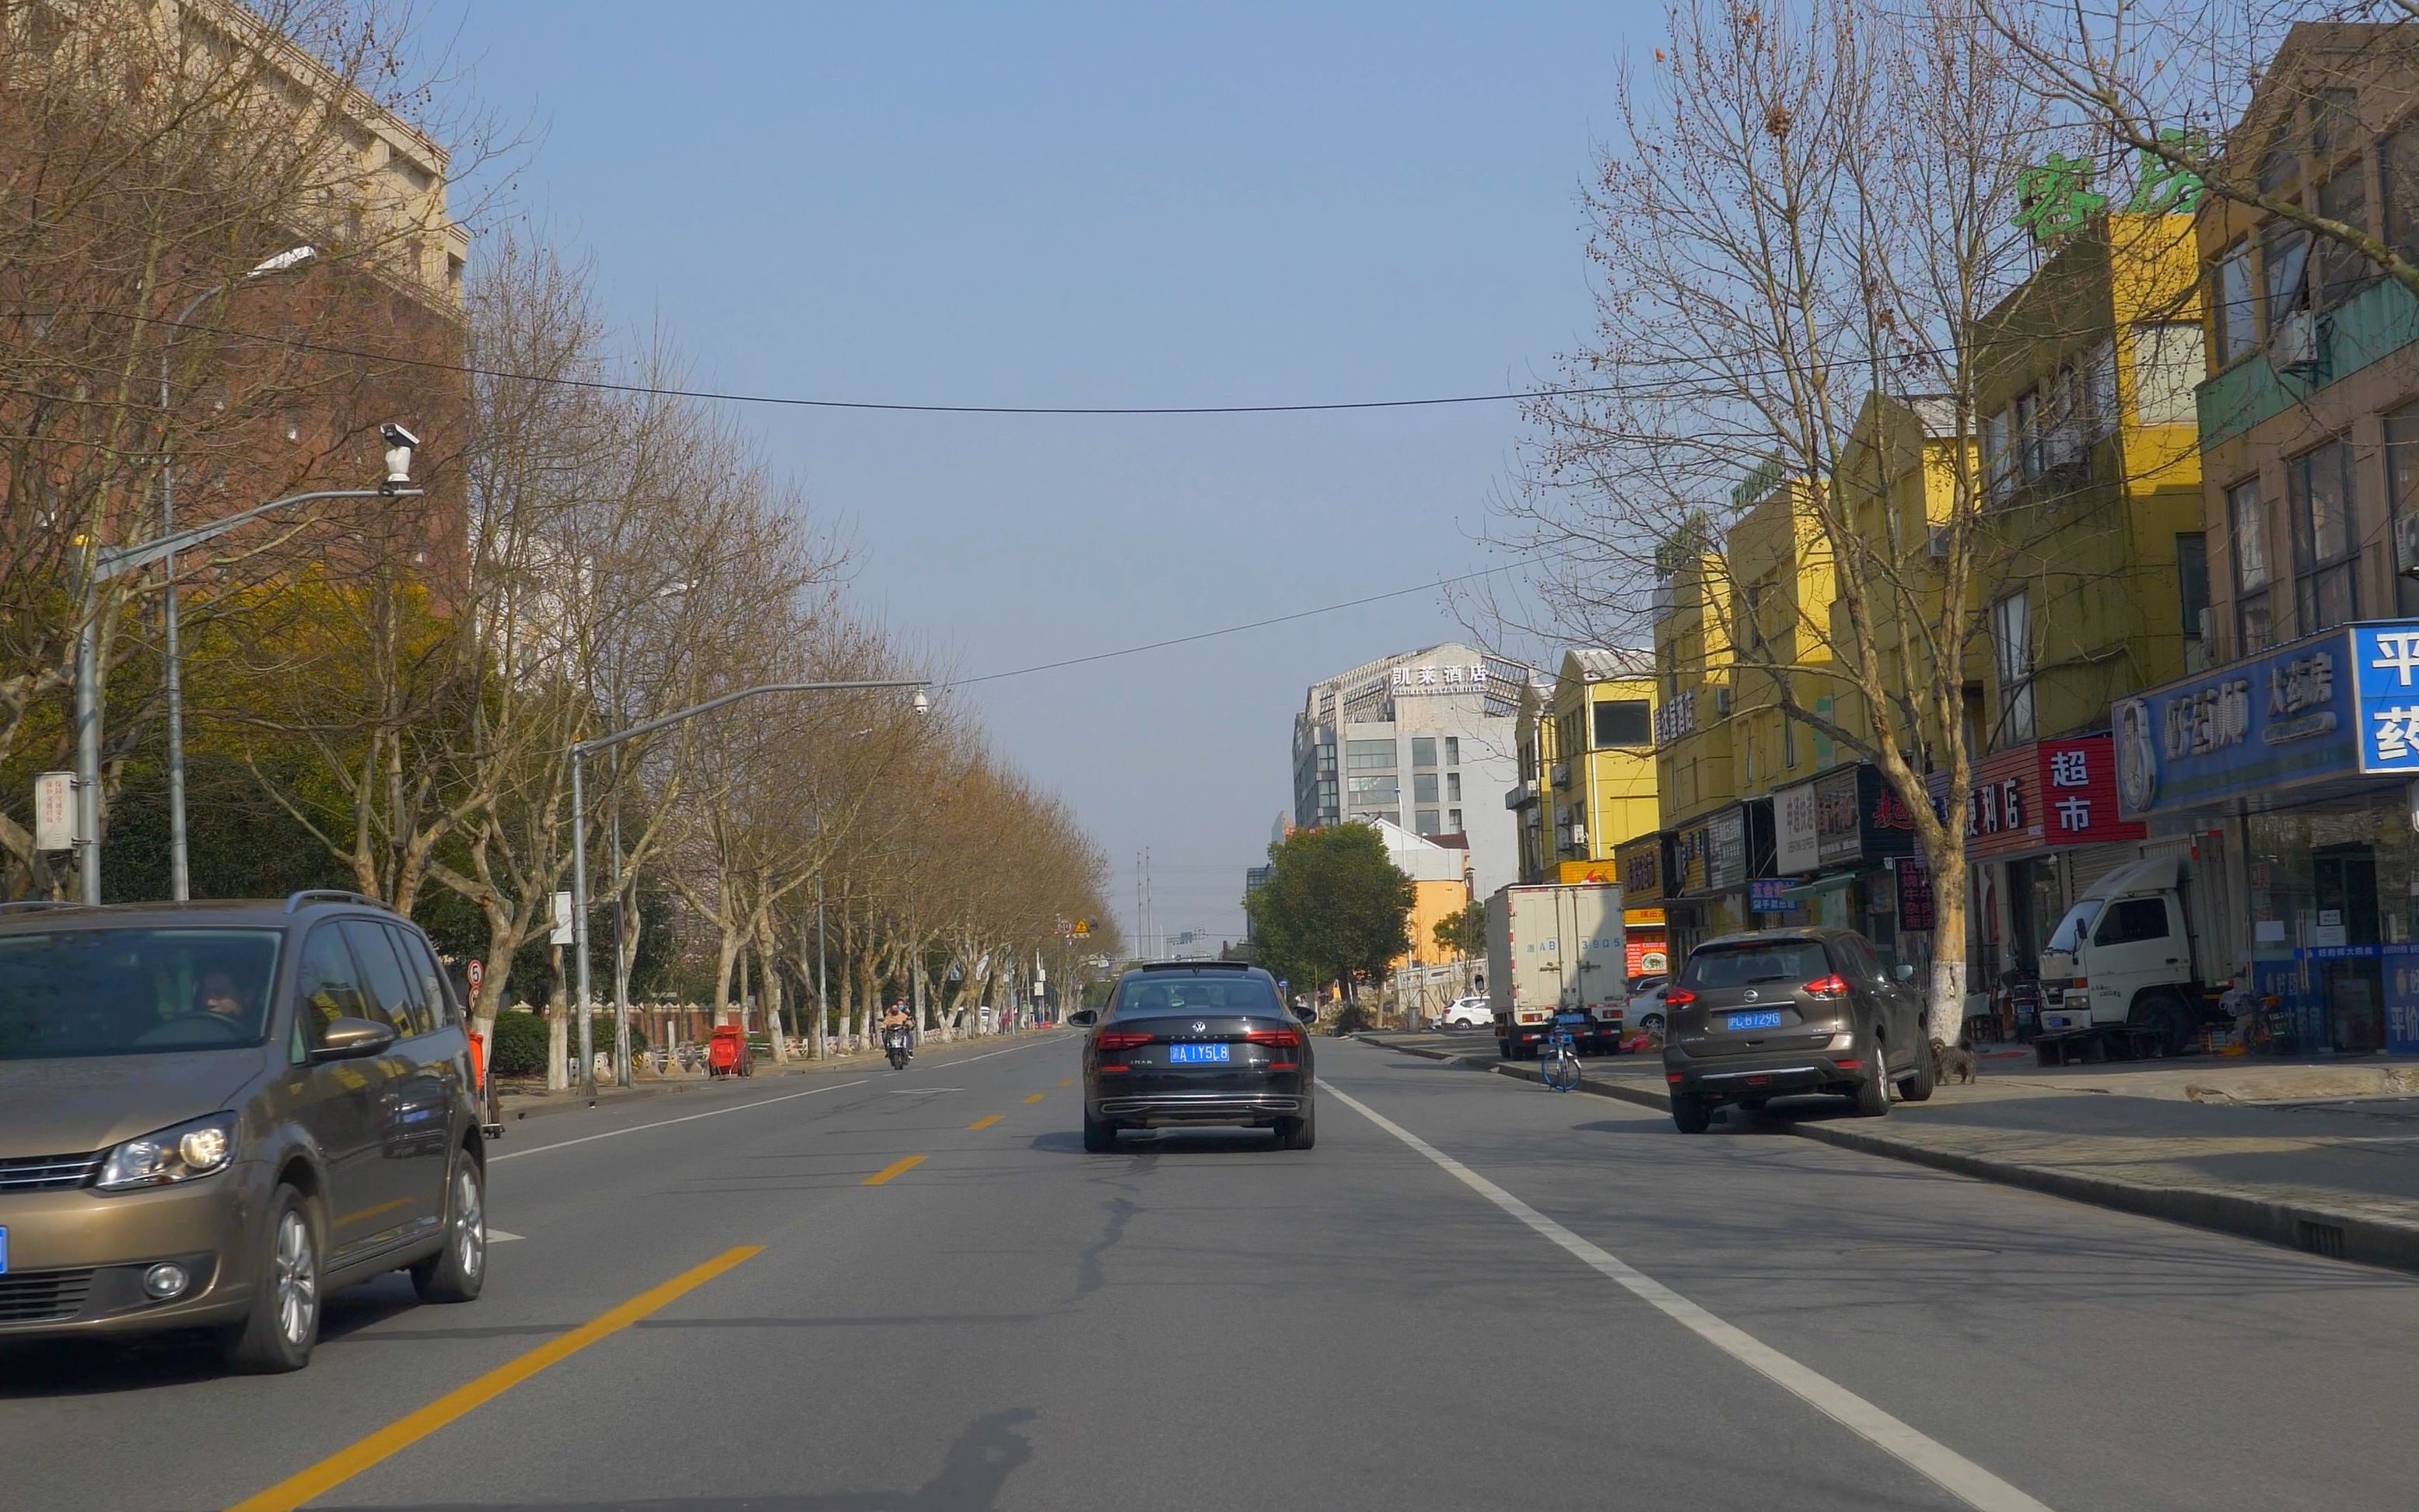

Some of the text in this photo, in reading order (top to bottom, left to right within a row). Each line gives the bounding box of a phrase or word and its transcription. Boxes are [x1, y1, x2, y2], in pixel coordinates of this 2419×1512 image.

[1392, 663, 1488, 685] 凯莱酒店
[2266, 652, 2333, 717] 大药房
[1966, 779, 2018, 836] 便利店
[2050, 751, 2091, 831] 超市
[472, 965, 479, 982] 5
